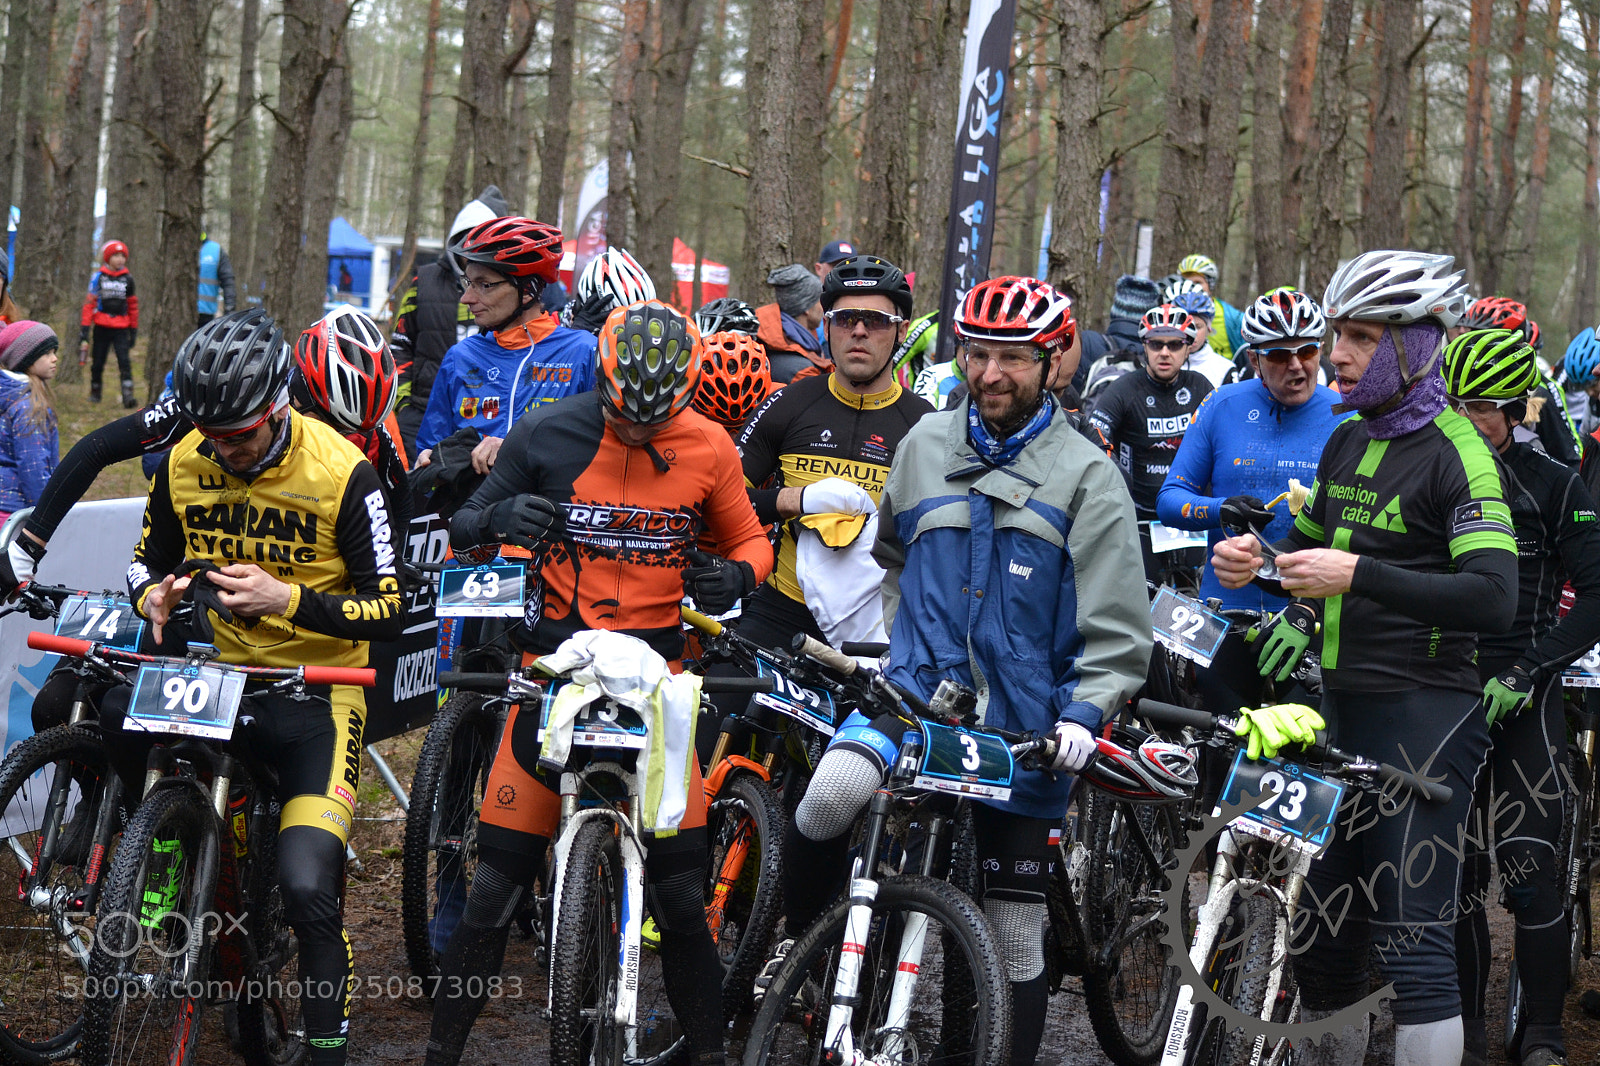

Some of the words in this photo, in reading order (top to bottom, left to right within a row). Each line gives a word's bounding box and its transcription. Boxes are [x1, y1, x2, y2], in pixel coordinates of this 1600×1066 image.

[963, 66, 990, 183] LIGA
[532, 367, 573, 383] MTB
[740, 389, 783, 444] RENAULT
[1150, 416, 1190, 434] MCP
[1277, 460, 1295, 468] MTB
[1297, 461, 1319, 470] TEAM
[185, 503, 317, 545] BARAN
[1193, 505, 1209, 519] IGT
[188, 532, 317, 564] CYCLING
[364, 489, 397, 575] BARAN
[462, 571, 500, 599] 63
[1008, 558, 1033, 580] KNAUF
[79, 607, 122, 640] 74
[1168, 605, 1205, 641] 92
[162, 676, 210, 714] 90
[771, 669, 821, 708] 109
[344, 708, 364, 792] BARAN
[959, 734, 980, 771] 3
[1257, 771, 1308, 821] 93
[86, 843, 105, 886] ROCKSHOX
[1569, 857, 1581, 896] ROCKSHOX
[772, 899, 852, 996] SCHWALB
[625, 944, 640, 991] ROCKSHOX
[1165, 1008, 1189, 1058] ROCKSHOX
